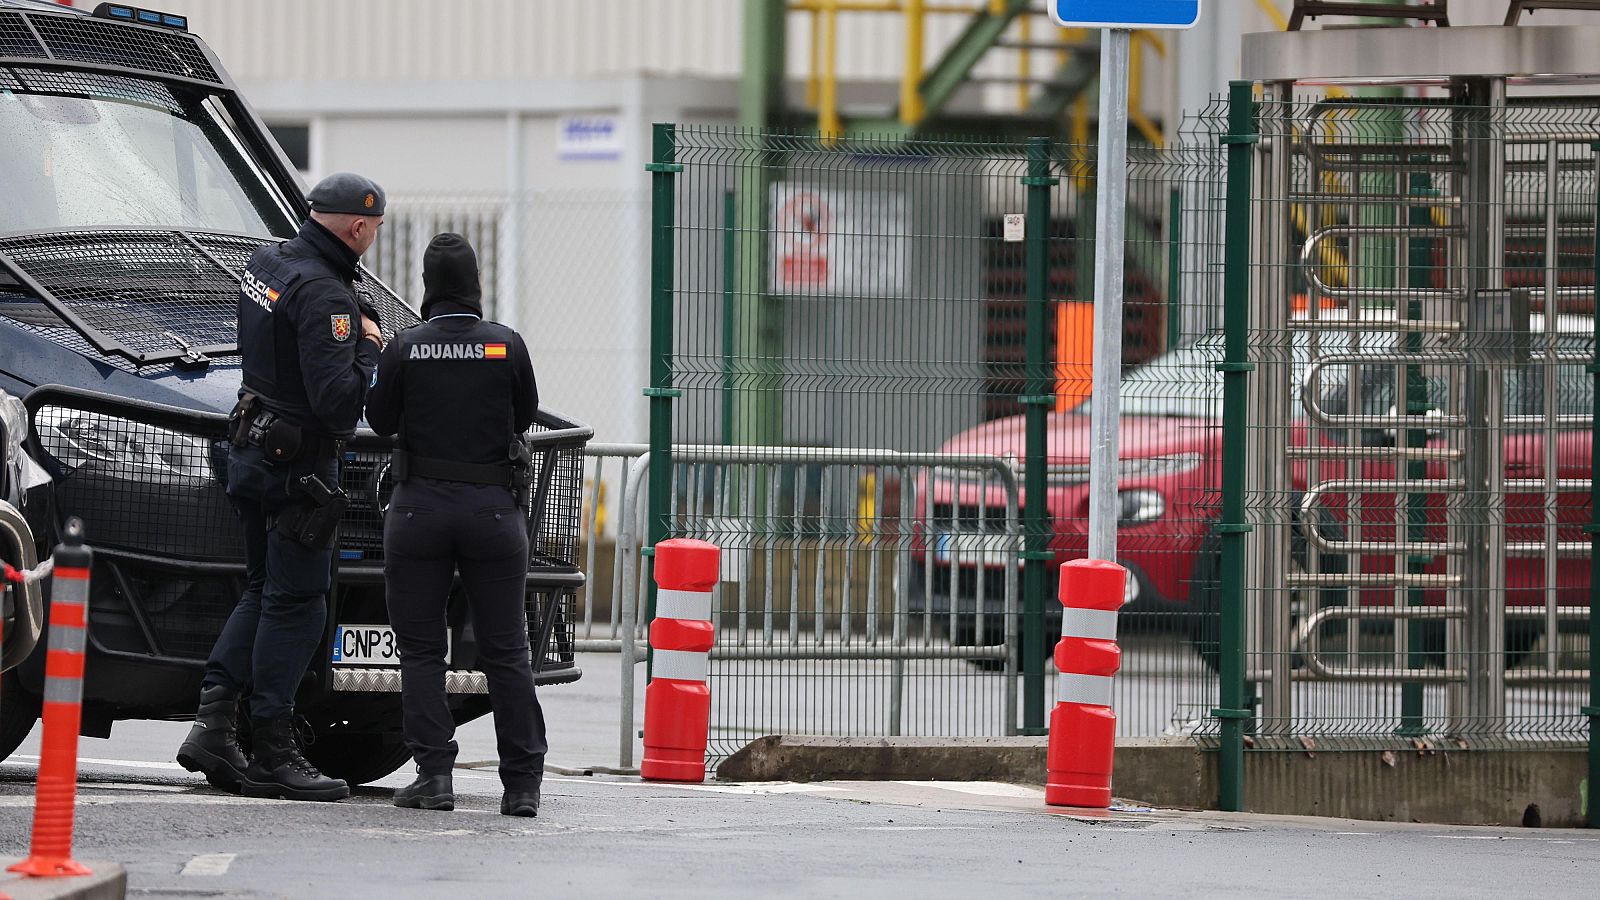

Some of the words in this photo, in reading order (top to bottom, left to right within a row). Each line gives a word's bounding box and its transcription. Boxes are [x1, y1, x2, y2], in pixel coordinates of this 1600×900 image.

[240, 280, 272, 312] NACIONAL
[409, 343, 484, 359] ADUANAS
[333, 647, 340, 656] E
